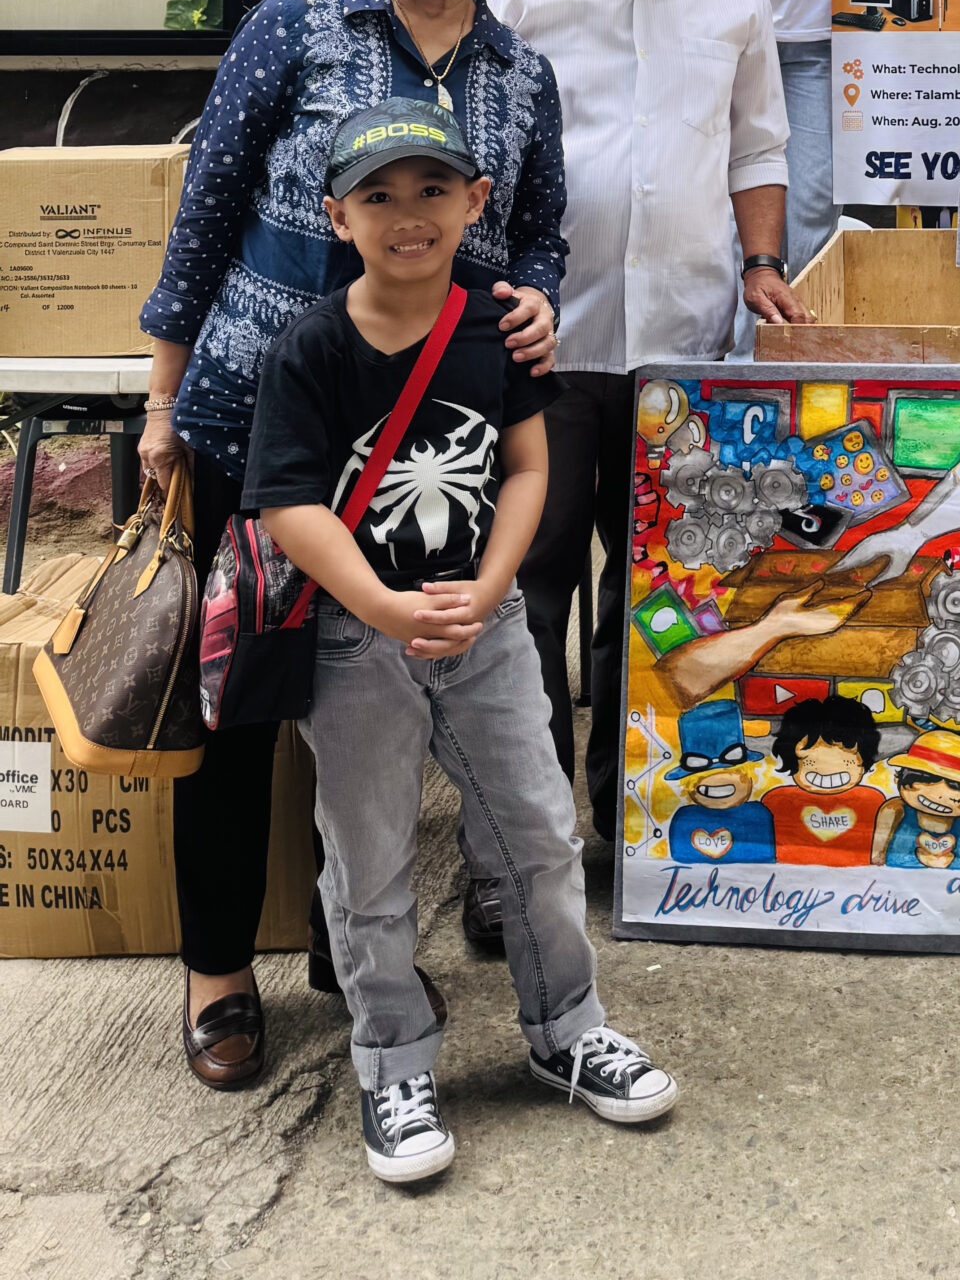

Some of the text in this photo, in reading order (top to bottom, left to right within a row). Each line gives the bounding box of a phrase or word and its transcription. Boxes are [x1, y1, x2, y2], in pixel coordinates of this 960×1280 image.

[872, 63, 906, 74] What:
[871, 89, 912, 100] Where:
[872, 116, 909, 127] When:
[912, 116, 942, 129] Aug.
[353, 123, 446, 151] #BOSS
[865, 151, 960, 181] SEE YO
[39, 204, 97, 216] VALIANT
[8, 230, 40, 238] Distributed
[83, 228, 132, 236] INFINUS
[4, 241, 37, 250] Compound
[147, 239, 162, 247] East
[86, 249, 99, 257] City
[40, 284, 73, 292] Composition
[0, 726, 56, 742] MODIT
[51, 769, 149, 794] X30 CM
[15, 785, 37, 793] VMC
[0, 799, 29, 809] OARD
[51, 808, 131, 834] 0 PCS
[809, 814, 849, 829] SHARE
[697, 834, 728, 848] LOVE
[923, 838, 949, 851] HOPE
[27, 847, 128, 872] 50X34X44
[0, 883, 103, 910] E IN CHINA
[653, 865, 922, 928] Technology drive
